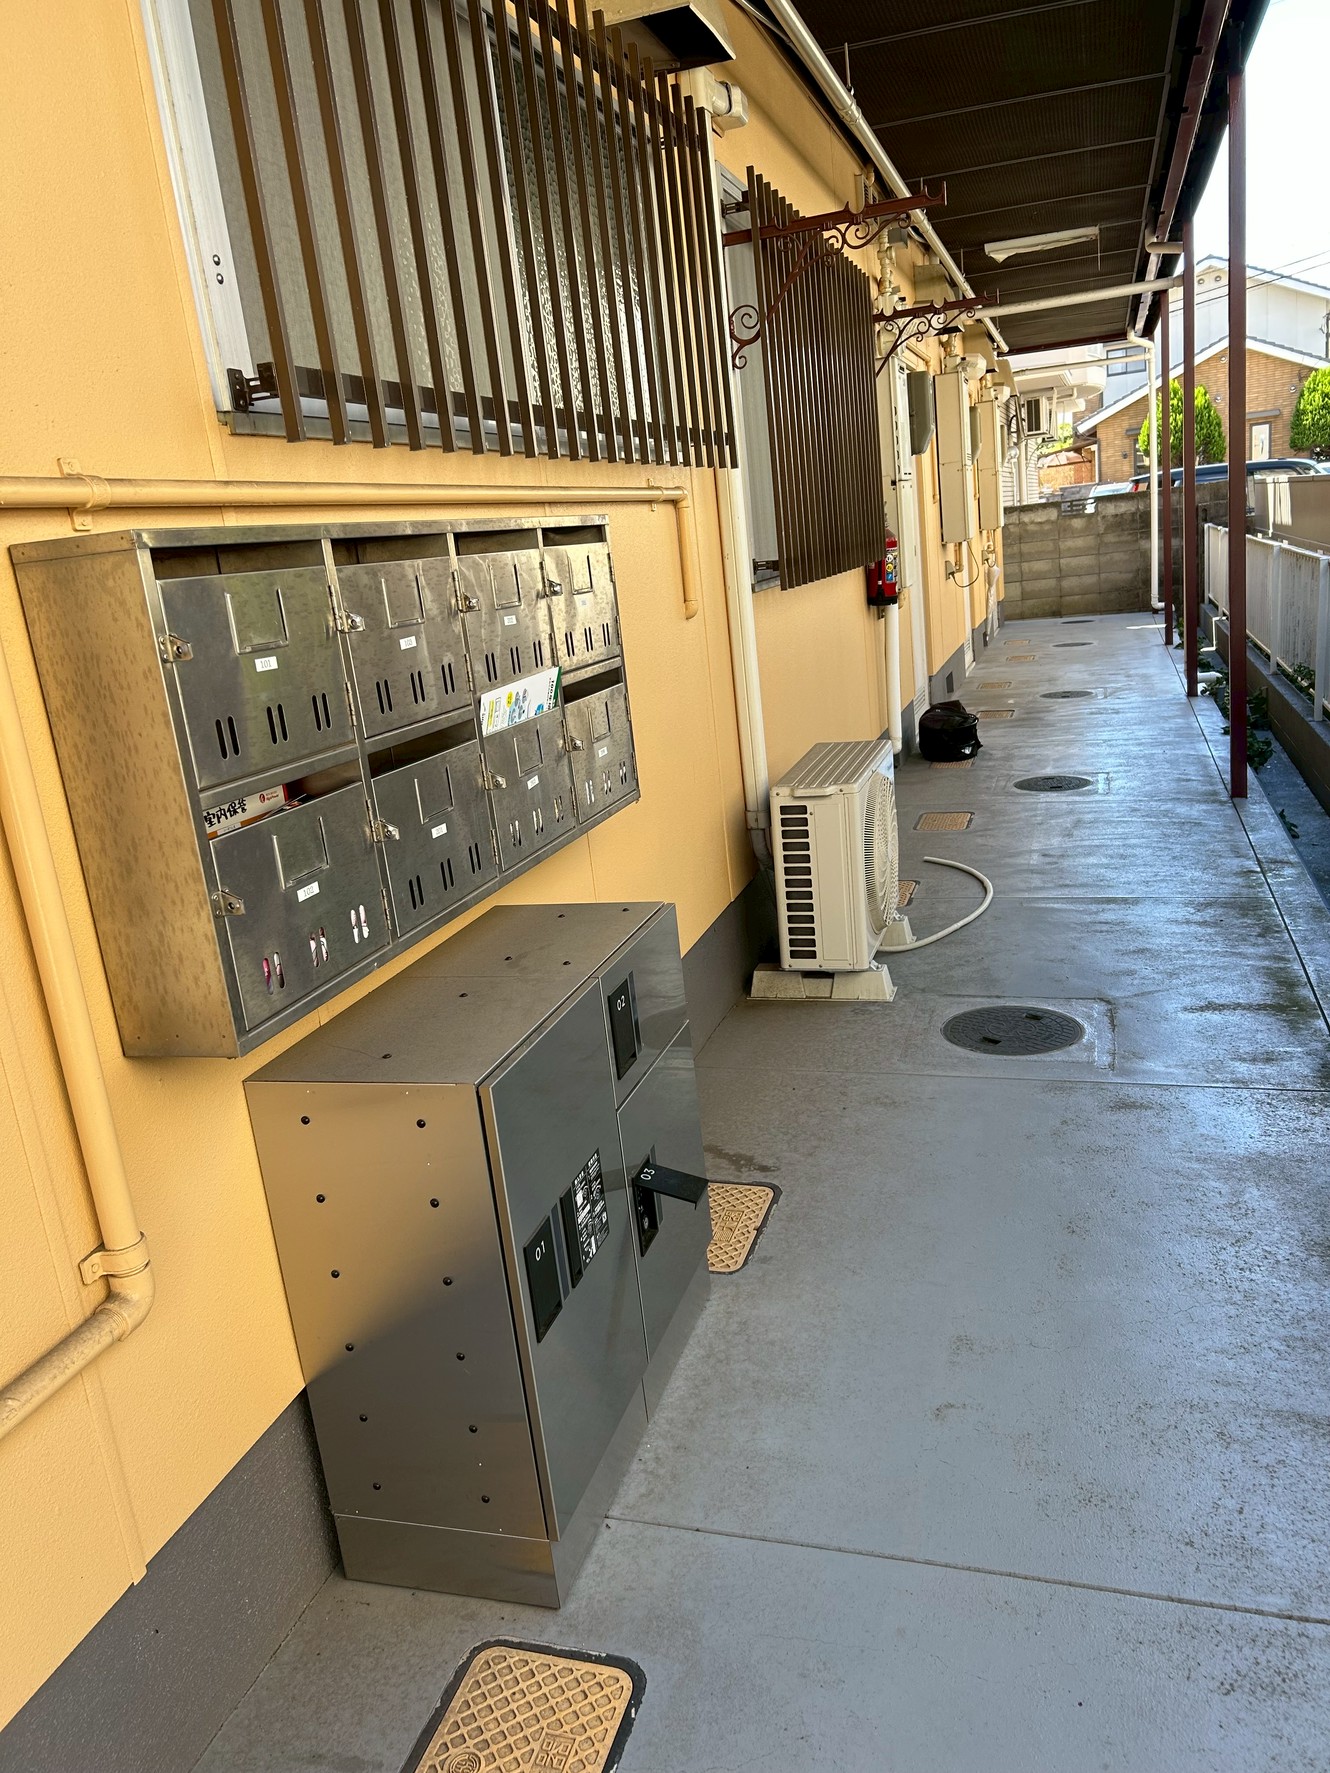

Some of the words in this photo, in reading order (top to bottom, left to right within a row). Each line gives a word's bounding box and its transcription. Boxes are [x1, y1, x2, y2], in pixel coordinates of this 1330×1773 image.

[616, 995, 626, 1011] 02
[640, 1167, 655, 1180] 03
[535, 1240, 546, 1261] 01
